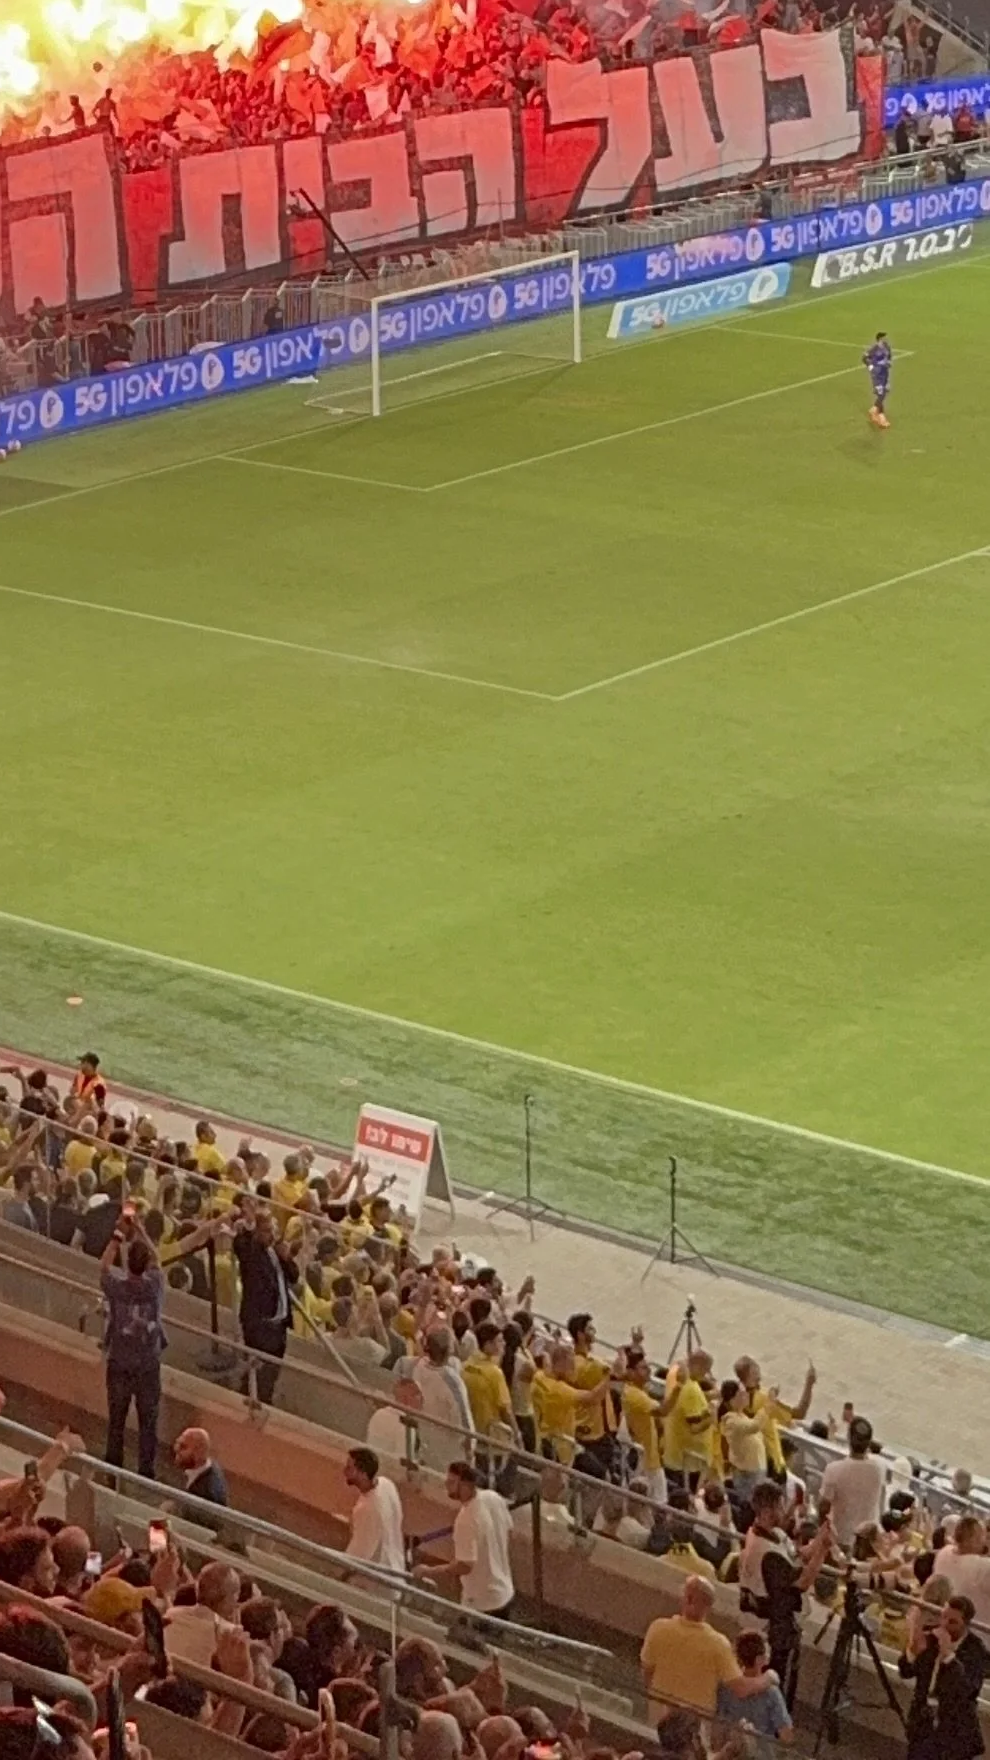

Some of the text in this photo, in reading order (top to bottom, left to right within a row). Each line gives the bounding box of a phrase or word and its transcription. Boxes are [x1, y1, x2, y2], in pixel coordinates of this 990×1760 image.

[543, 28, 860, 210] בעל
[167, 106, 517, 284] הבית
[890, 186, 978, 227] פלאפון 5G
[770, 209, 863, 252] פלאפון 5G
[646, 252, 671, 280] 5G
[513, 280, 540, 309] 5G
[664, 281, 748, 324] פלאפון
[378, 293, 485, 342] פלאפון 5G
[232, 347, 262, 378] 5G
[74, 362, 198, 416] פלאפון 5G
